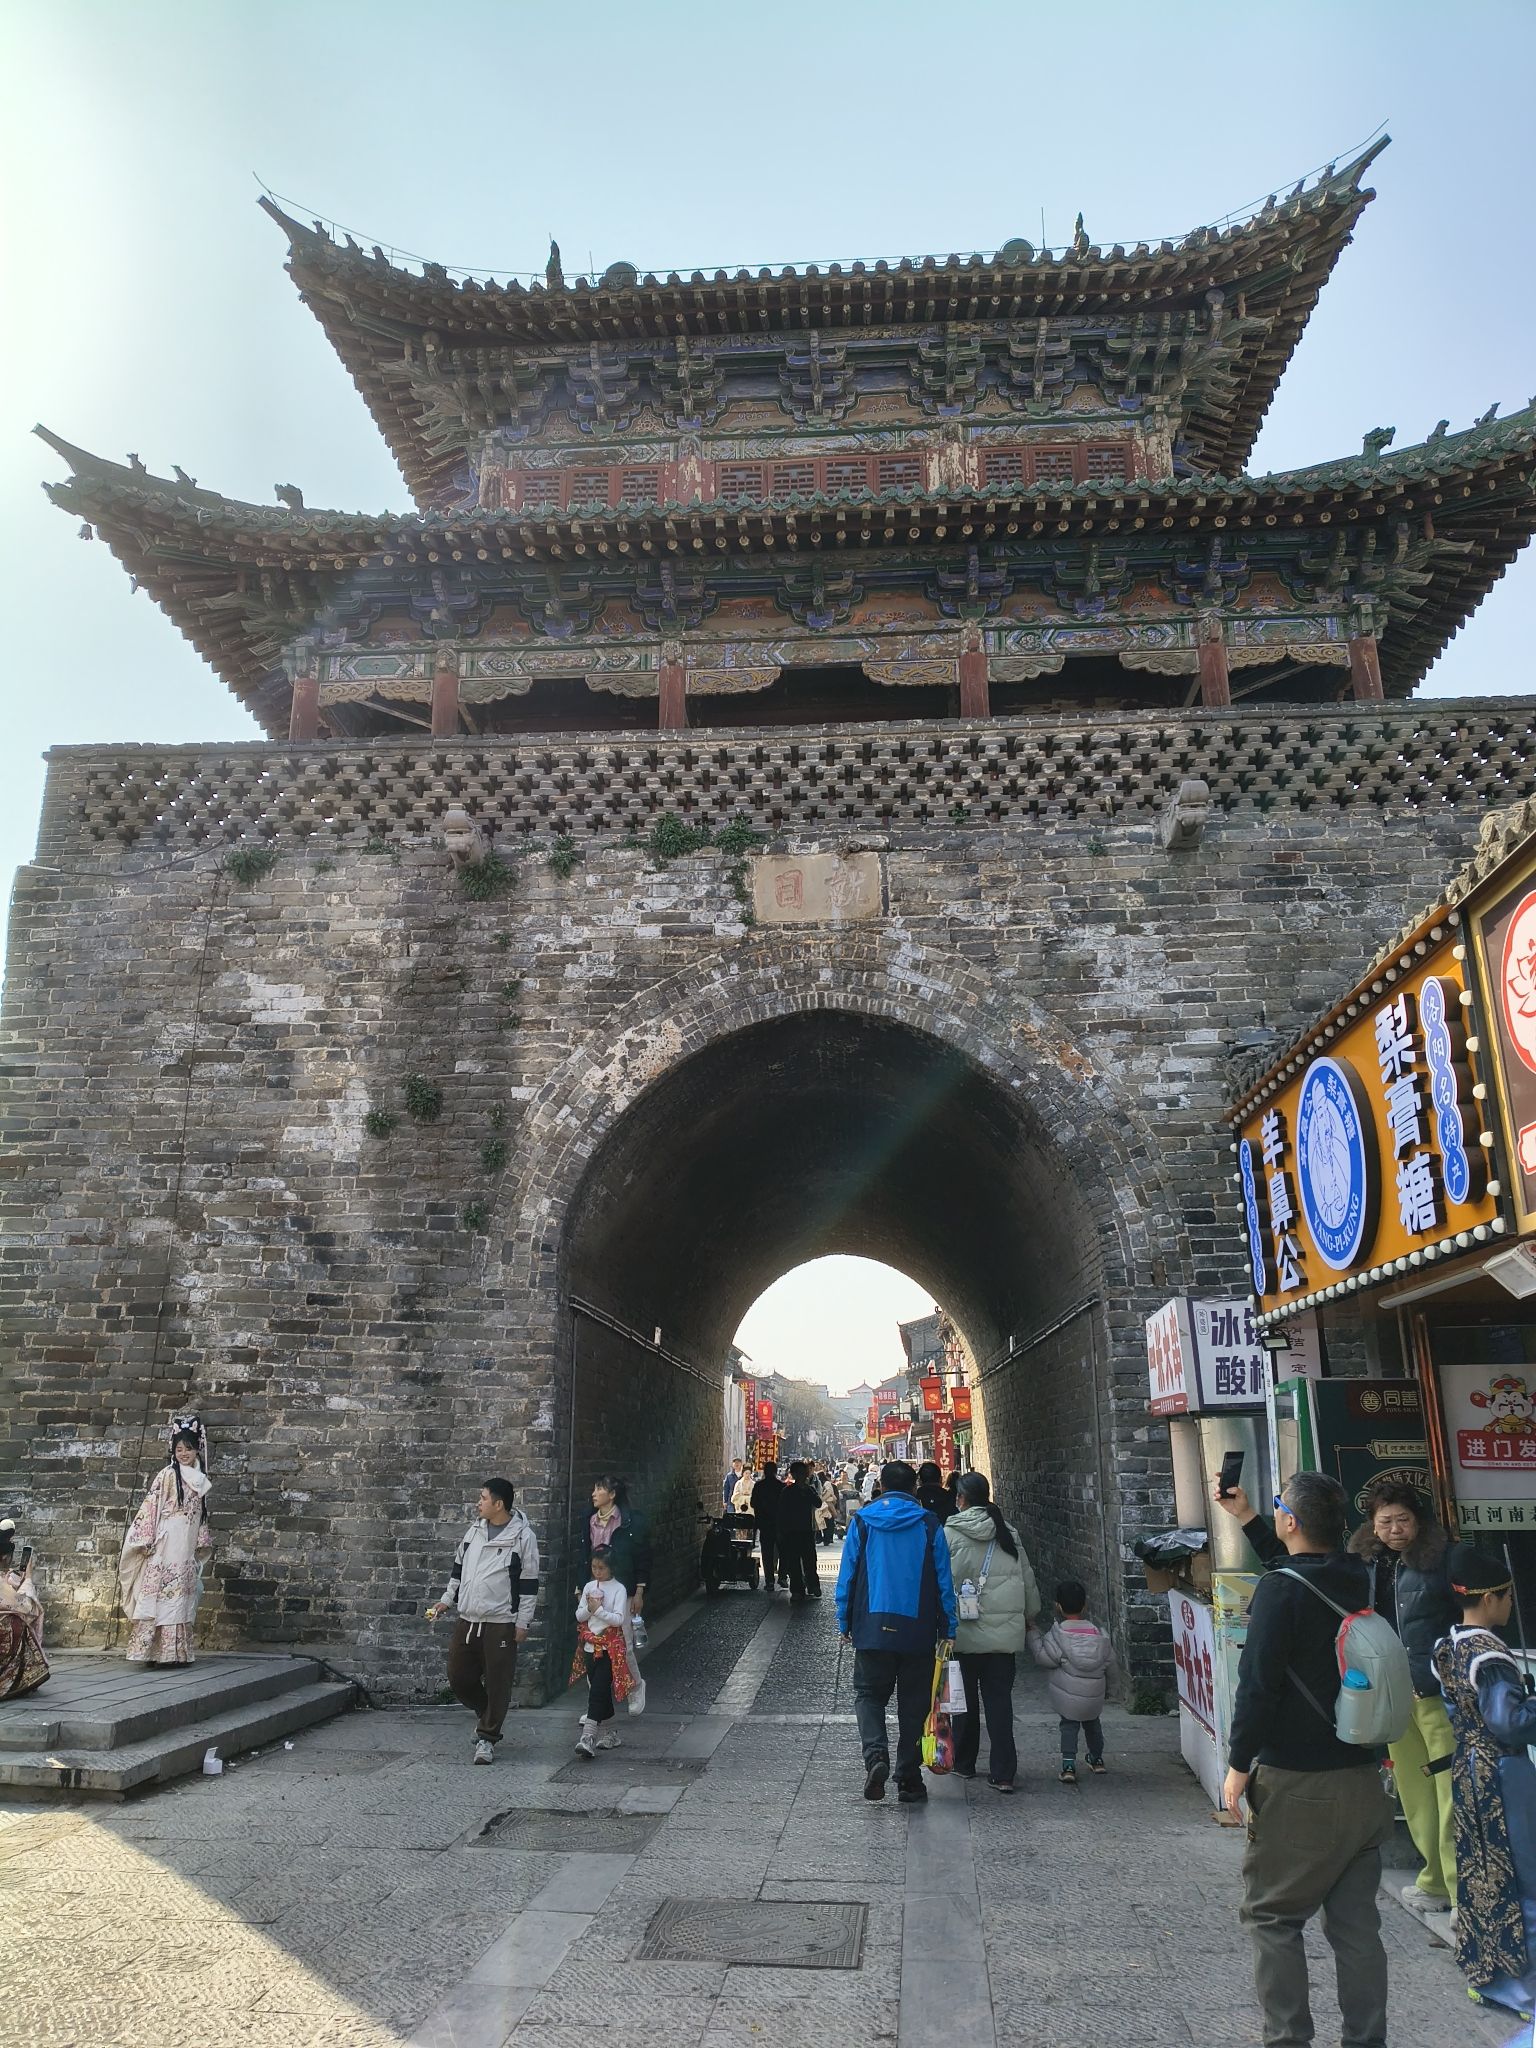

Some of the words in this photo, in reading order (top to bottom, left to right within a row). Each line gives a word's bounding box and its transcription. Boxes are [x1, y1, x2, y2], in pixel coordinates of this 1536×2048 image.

[1375, 992, 1436, 1237] 梨膏糖
[1426, 995, 1462, 1194] 洛阳名特产
[1261, 1108, 1299, 1292] 羊鼻公
[1314, 1192, 1359, 1252] YANG-PI-KUNG
[1384, 1390, 1422, 1407] 同善
[1466, 1438, 1536, 1458] 进门发
